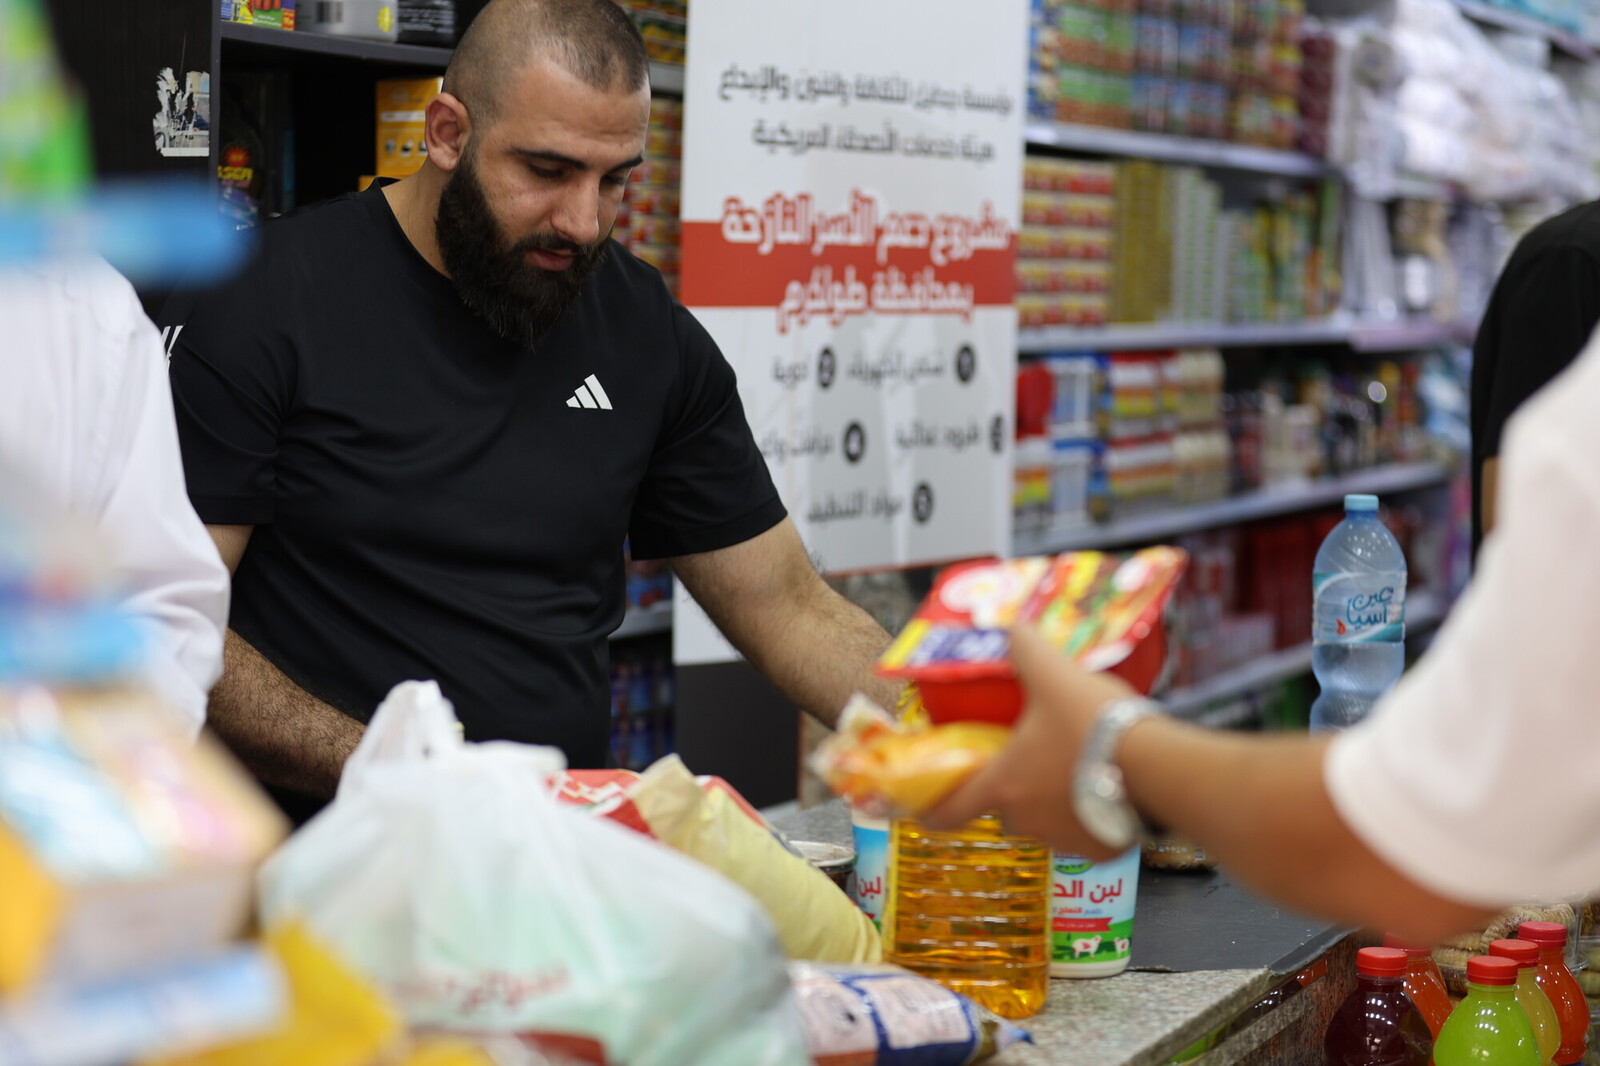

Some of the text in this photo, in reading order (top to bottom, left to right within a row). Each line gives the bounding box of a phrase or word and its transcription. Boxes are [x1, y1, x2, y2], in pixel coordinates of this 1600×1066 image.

[777, 264, 868, 334] طولكرم
[858, 876, 881, 900] لبن
[1089, 878, 1122, 904] لبن
